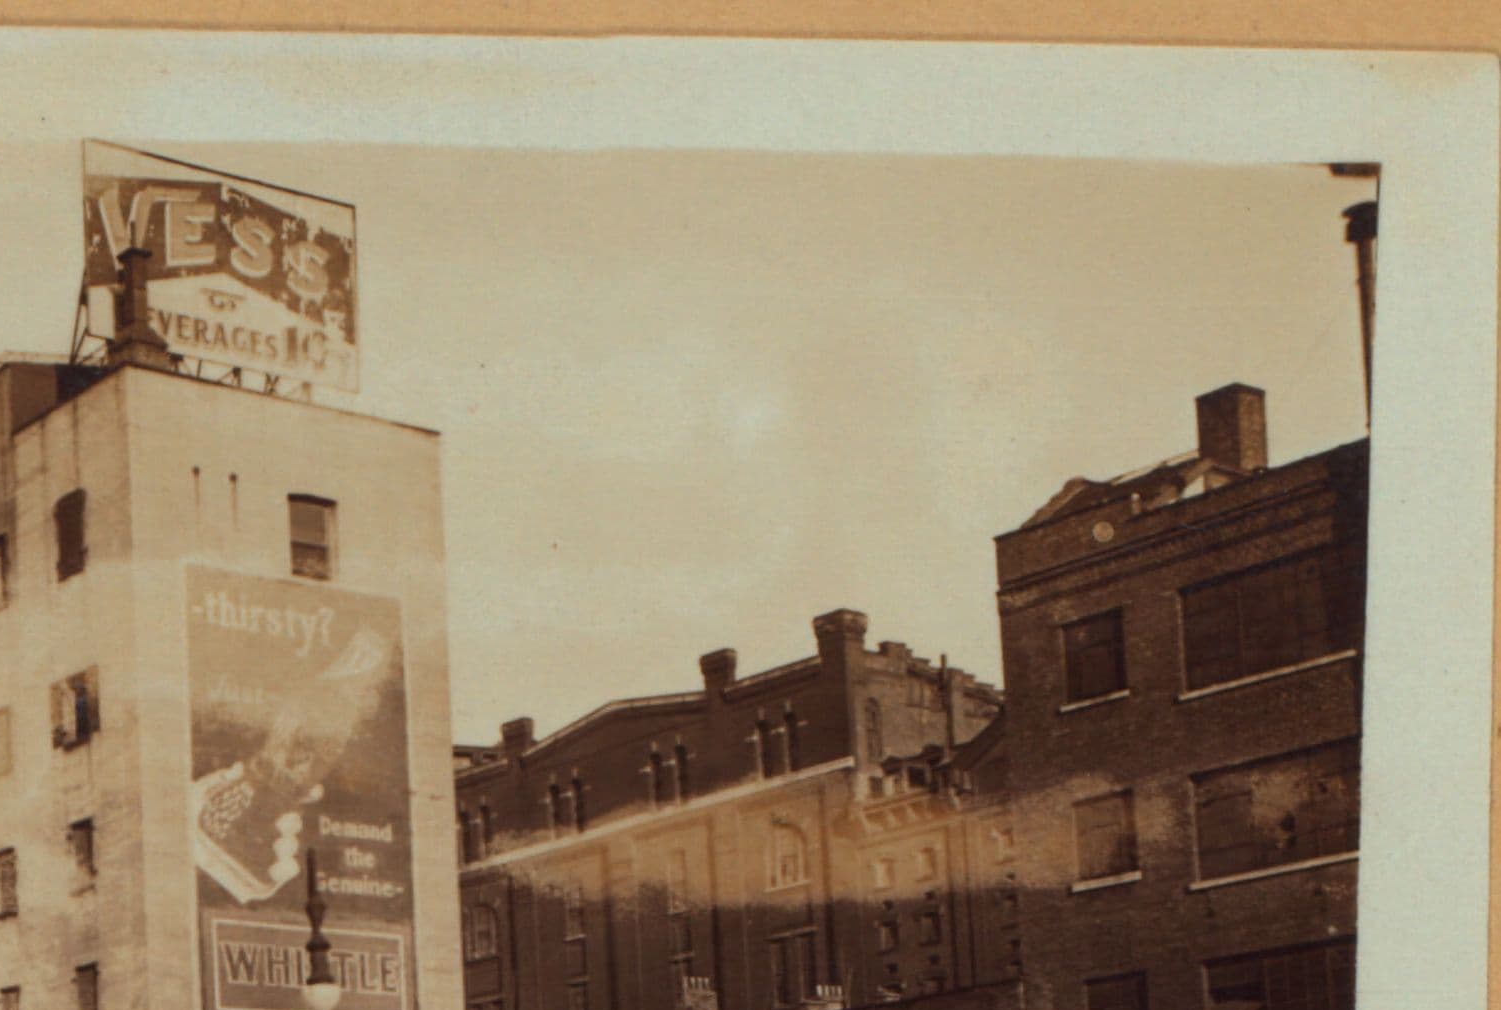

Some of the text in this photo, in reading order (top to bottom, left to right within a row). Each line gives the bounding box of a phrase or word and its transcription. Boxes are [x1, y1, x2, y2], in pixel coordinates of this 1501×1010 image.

[99, 184, 332, 300] VESS
[148, 308, 277, 362] VERAGES
[318, 814, 393, 843] Demand
[343, 845, 376, 869] the
[219, 941, 400, 996] WHITLE
